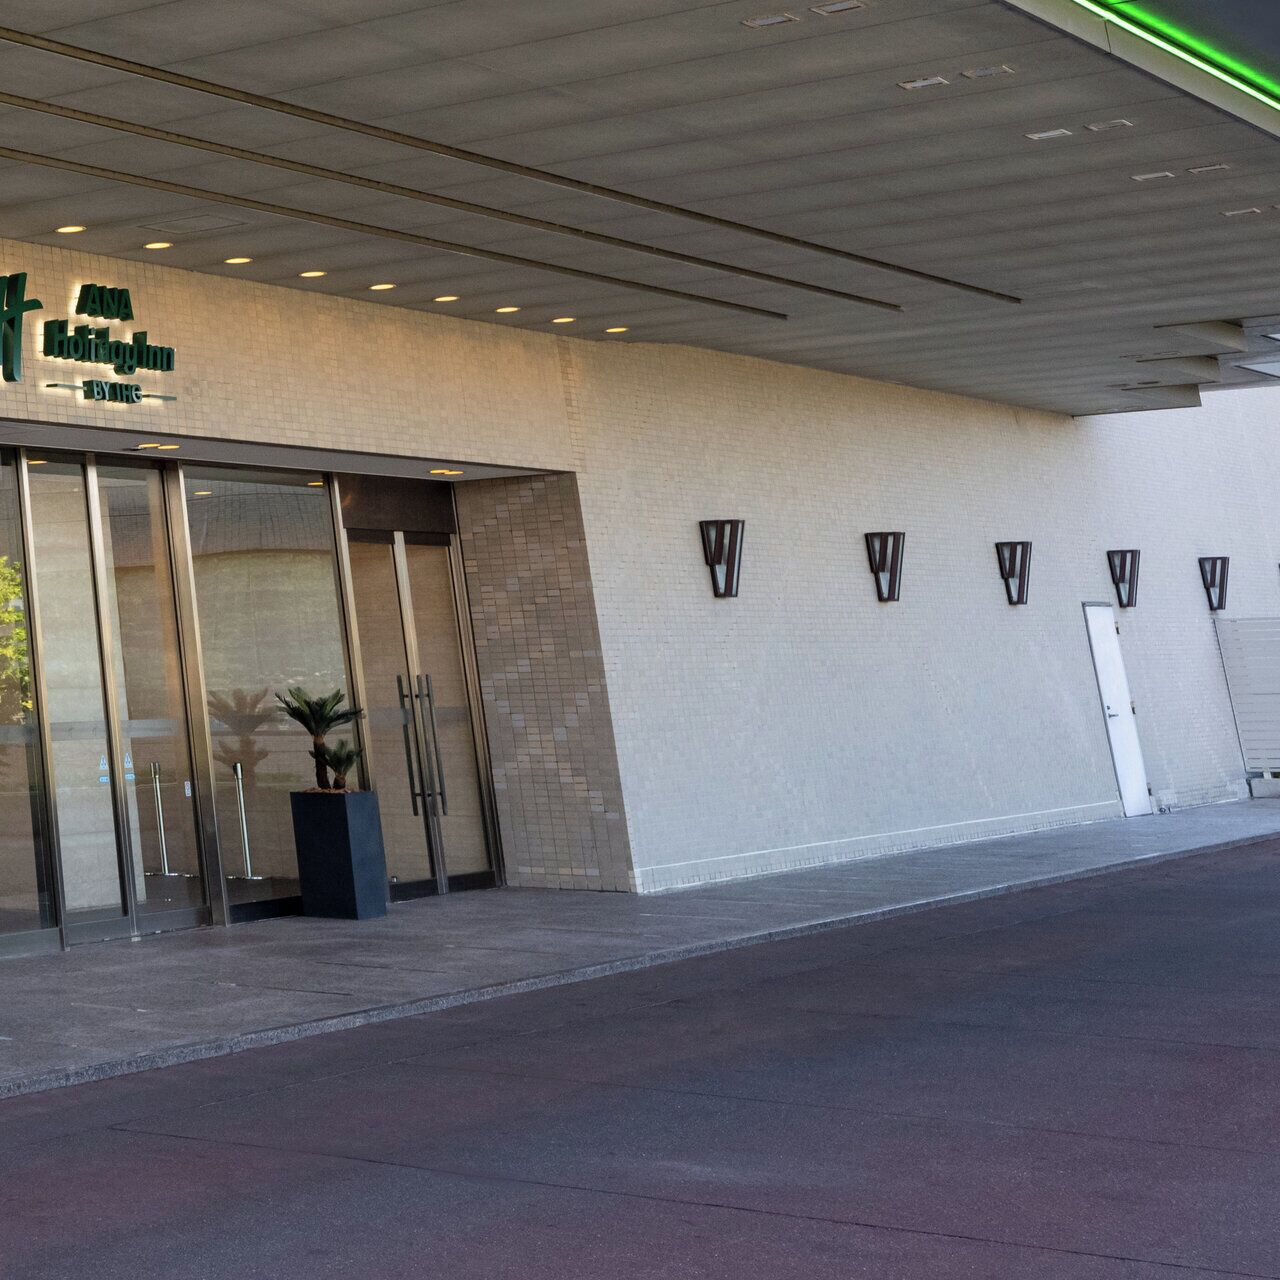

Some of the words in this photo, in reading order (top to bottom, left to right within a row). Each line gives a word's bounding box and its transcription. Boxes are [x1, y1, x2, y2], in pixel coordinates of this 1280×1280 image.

[76, 283, 135, 321] ANA
[43, 319, 137, 375] Holiday
[134, 331, 175, 372] Inn
[85, 379, 110, 401] BY
[112, 382, 143, 404] IHG
